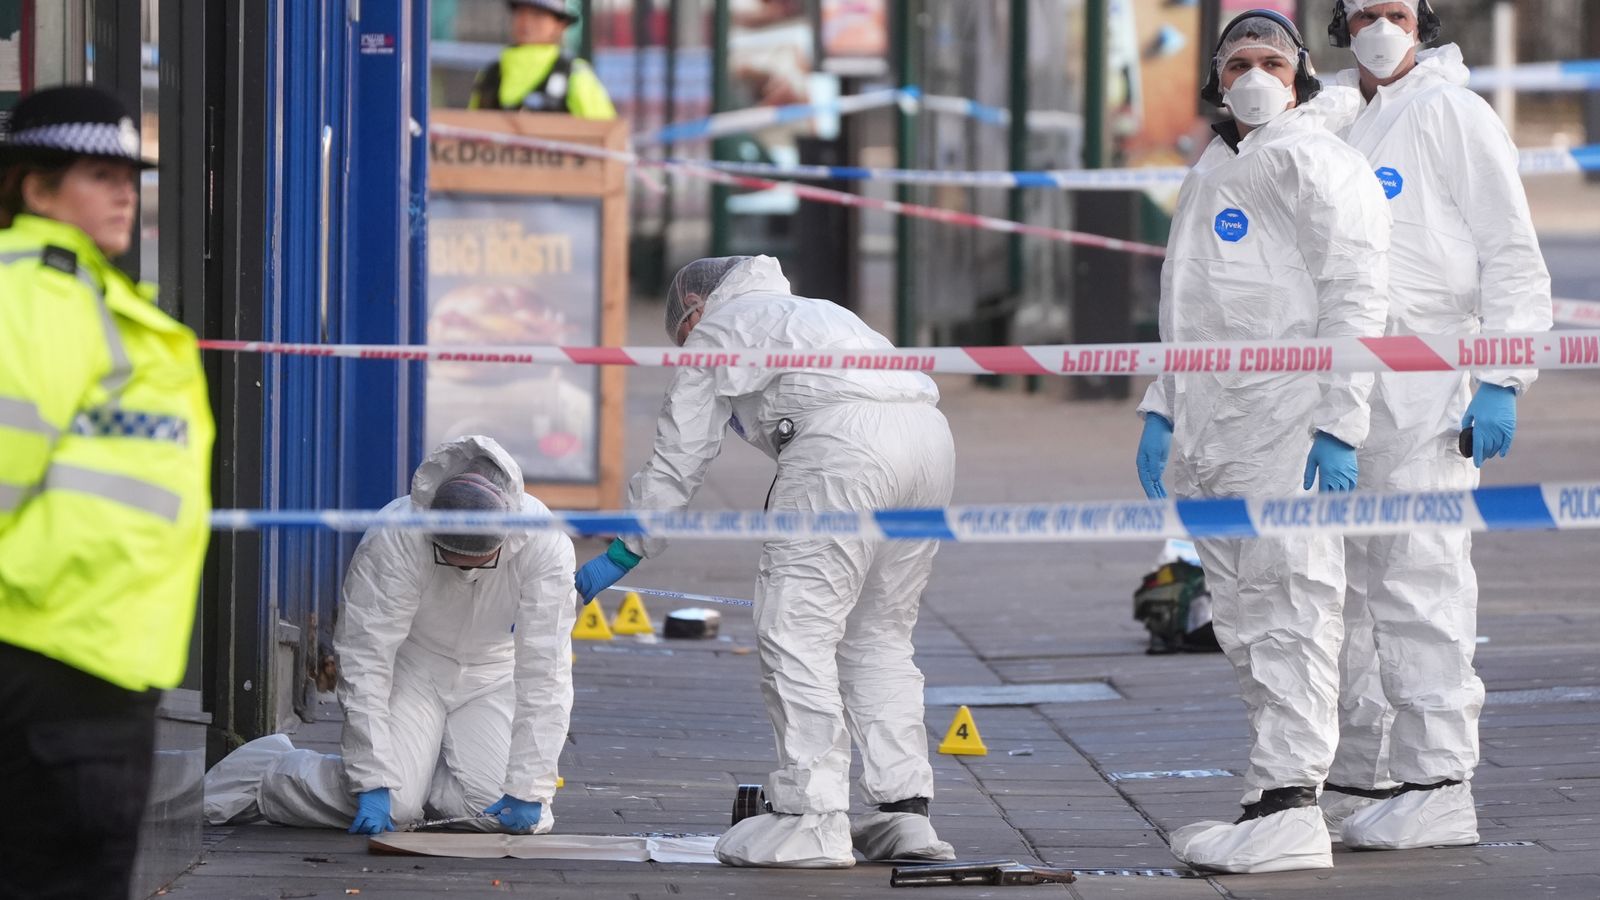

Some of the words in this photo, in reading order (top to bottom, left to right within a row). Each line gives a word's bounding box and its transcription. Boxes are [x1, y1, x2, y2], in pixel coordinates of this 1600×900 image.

[1220, 219, 1243, 230] Tyvek
[1261, 499, 1313, 527] POLICE
[1316, 499, 1349, 527] LINE
[1354, 497, 1377, 525] DO
[1379, 495, 1410, 524] NOT
[1412, 493, 1464, 524] CROSS
[586, 613, 598, 629] 3
[627, 607, 640, 624] 2
[955, 723, 969, 740] 4
